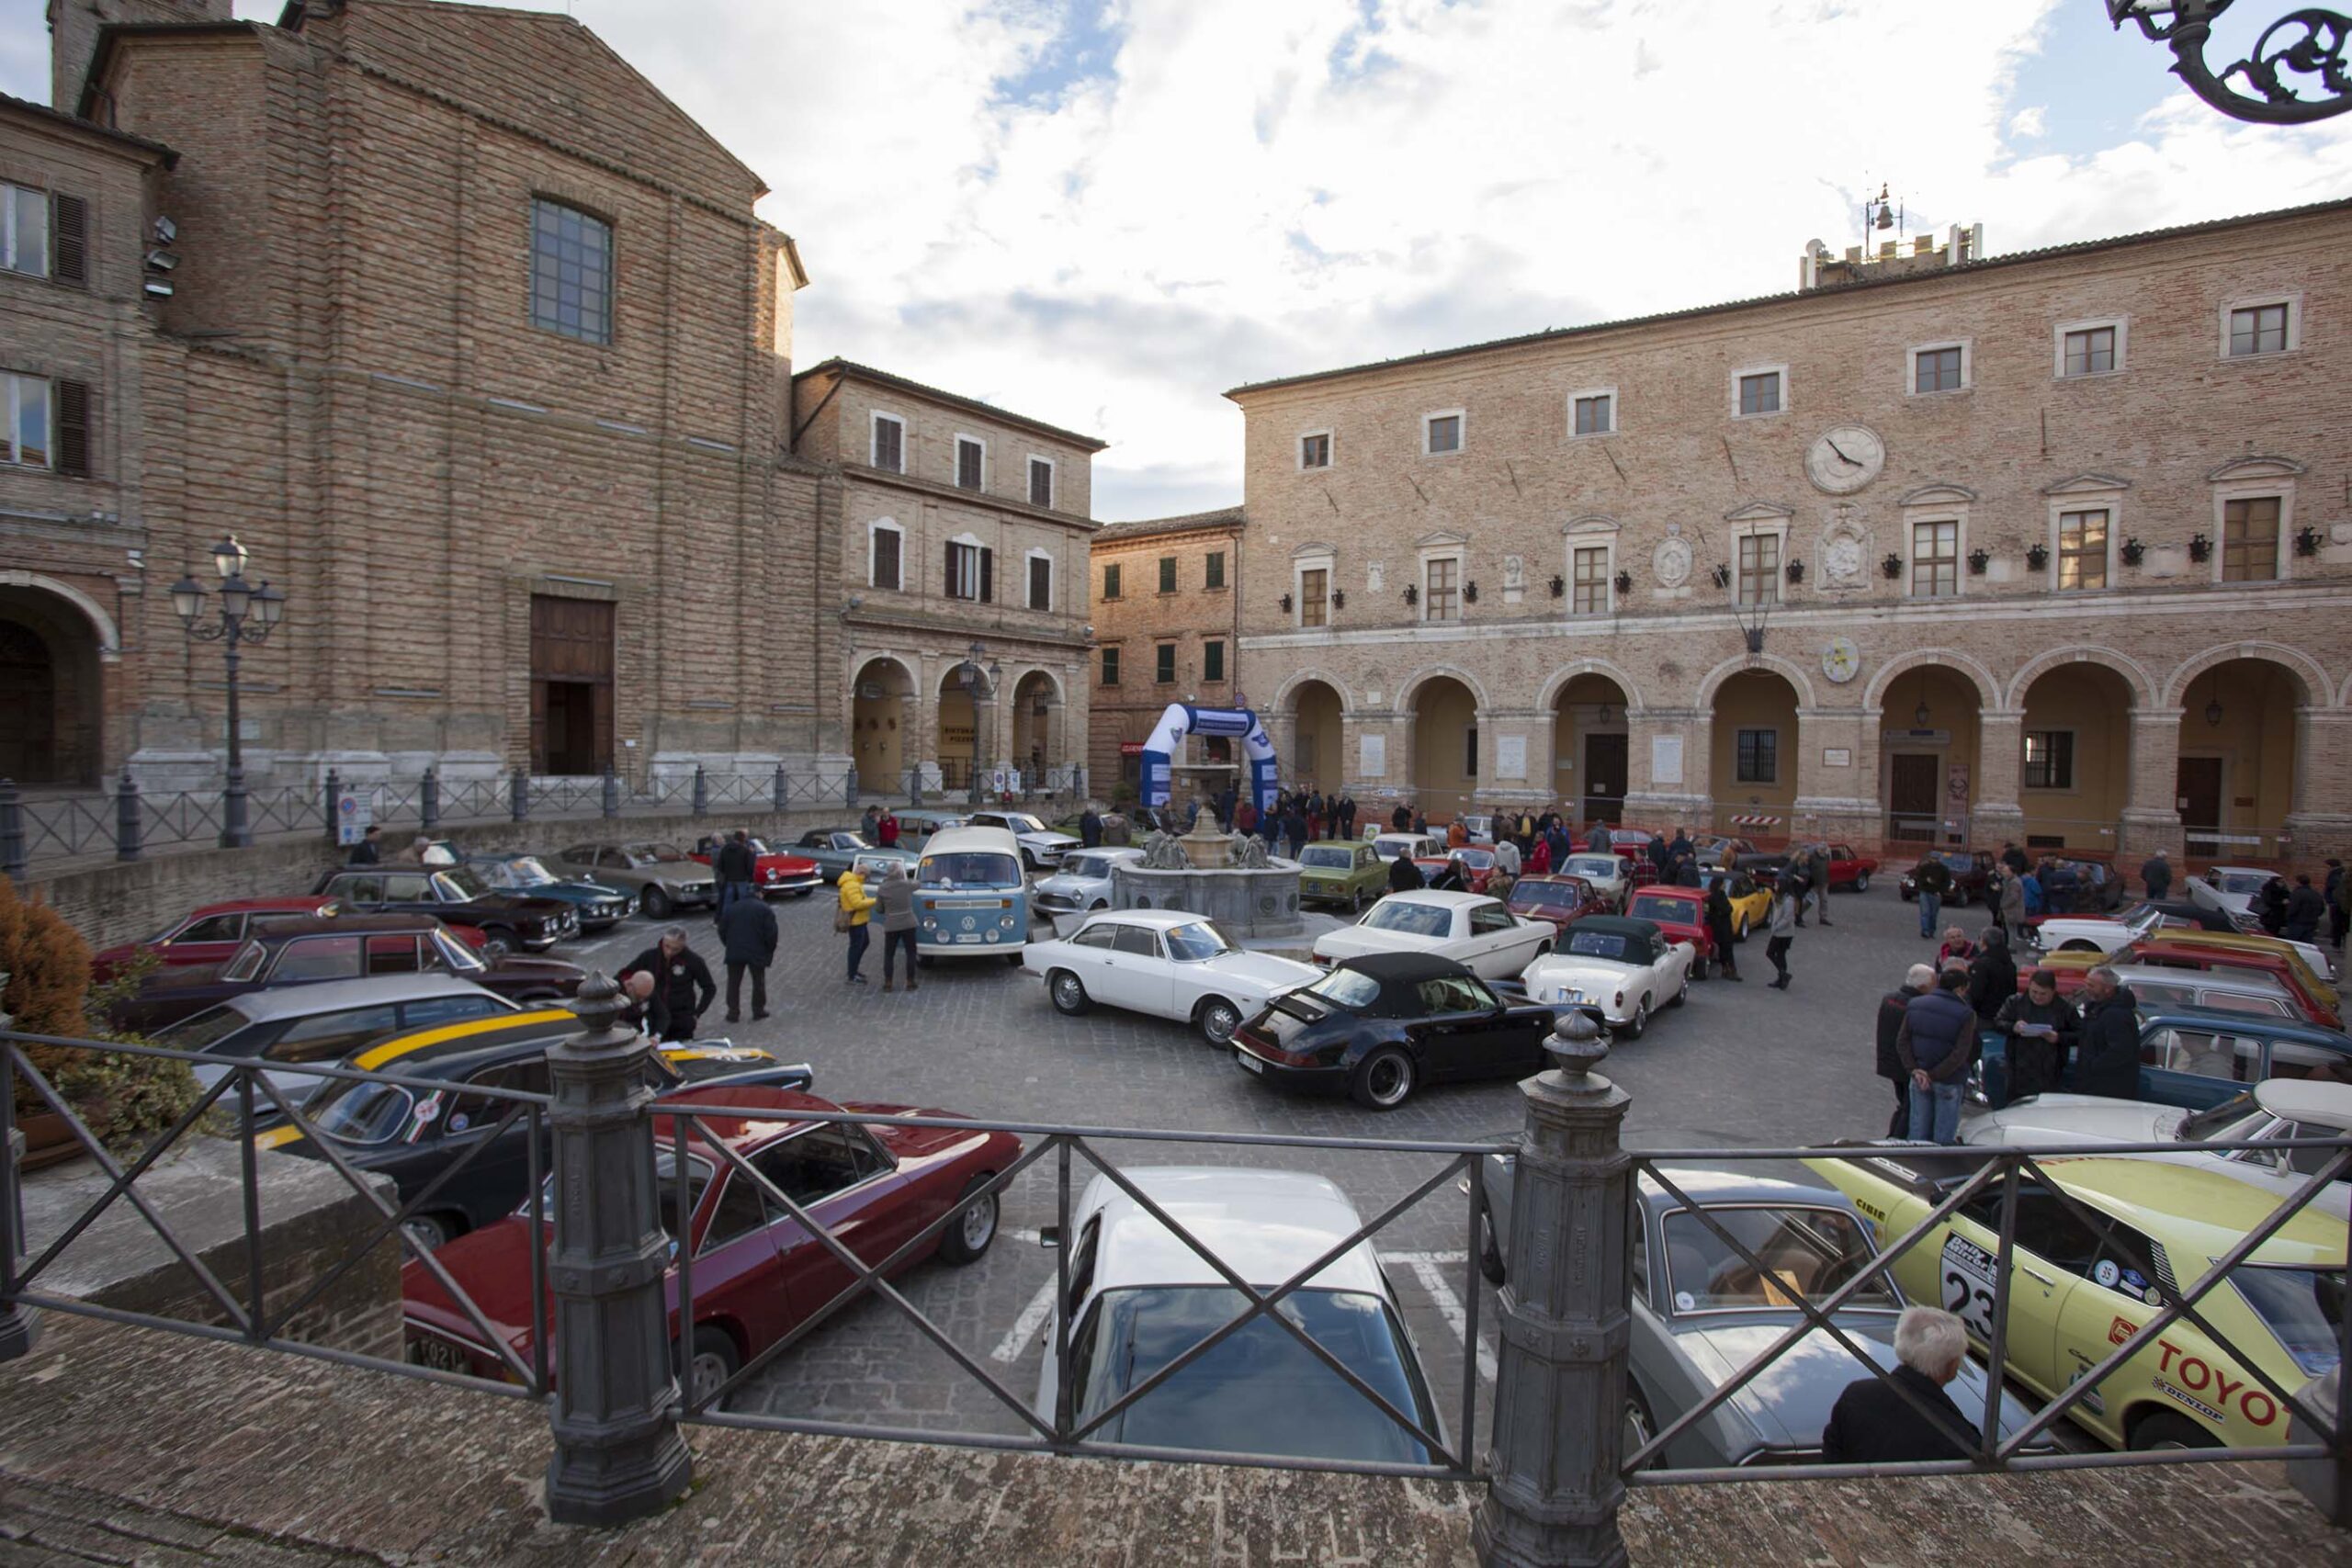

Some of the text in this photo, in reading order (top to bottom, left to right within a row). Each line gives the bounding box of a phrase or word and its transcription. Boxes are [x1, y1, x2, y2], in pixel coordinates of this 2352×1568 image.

[1856, 1198, 1885, 1222] CIBIE
[1946, 1242, 1988, 1271] Mirror
[1949, 1235, 1986, 1261] Daily
[1946, 1272, 1995, 1340] 23
[2165, 1386, 2223, 1422] DUNLOP
